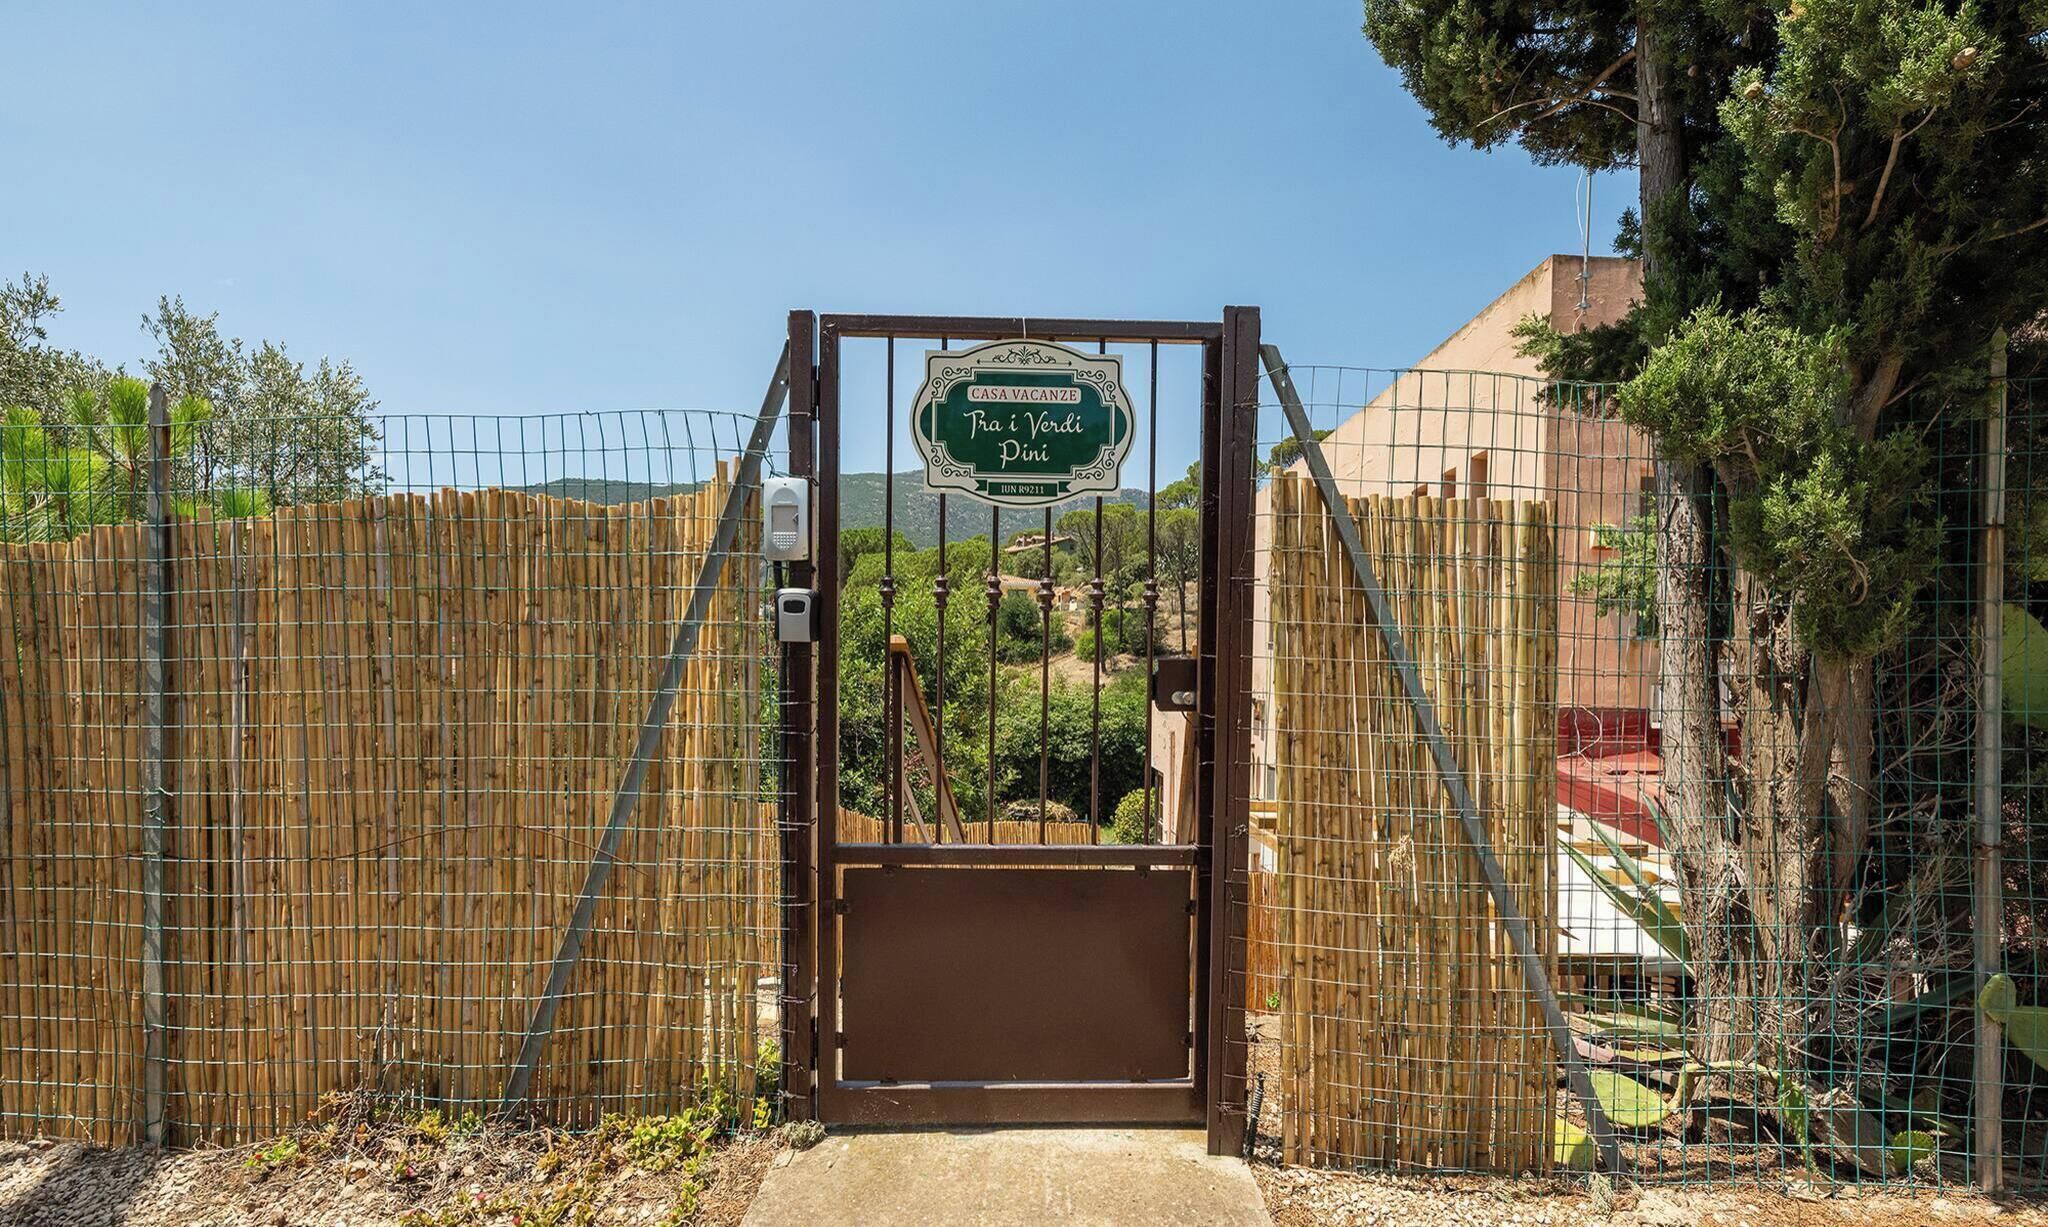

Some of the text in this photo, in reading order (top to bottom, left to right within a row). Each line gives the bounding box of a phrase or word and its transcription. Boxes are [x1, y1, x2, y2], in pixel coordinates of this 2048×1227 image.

[971, 388, 1077, 401] CASA VACANZE
[963, 410, 1083, 440] Tra i Verdi
[998, 439, 1050, 469] Pini
[1001, 484, 1044, 495] IUN R9211
